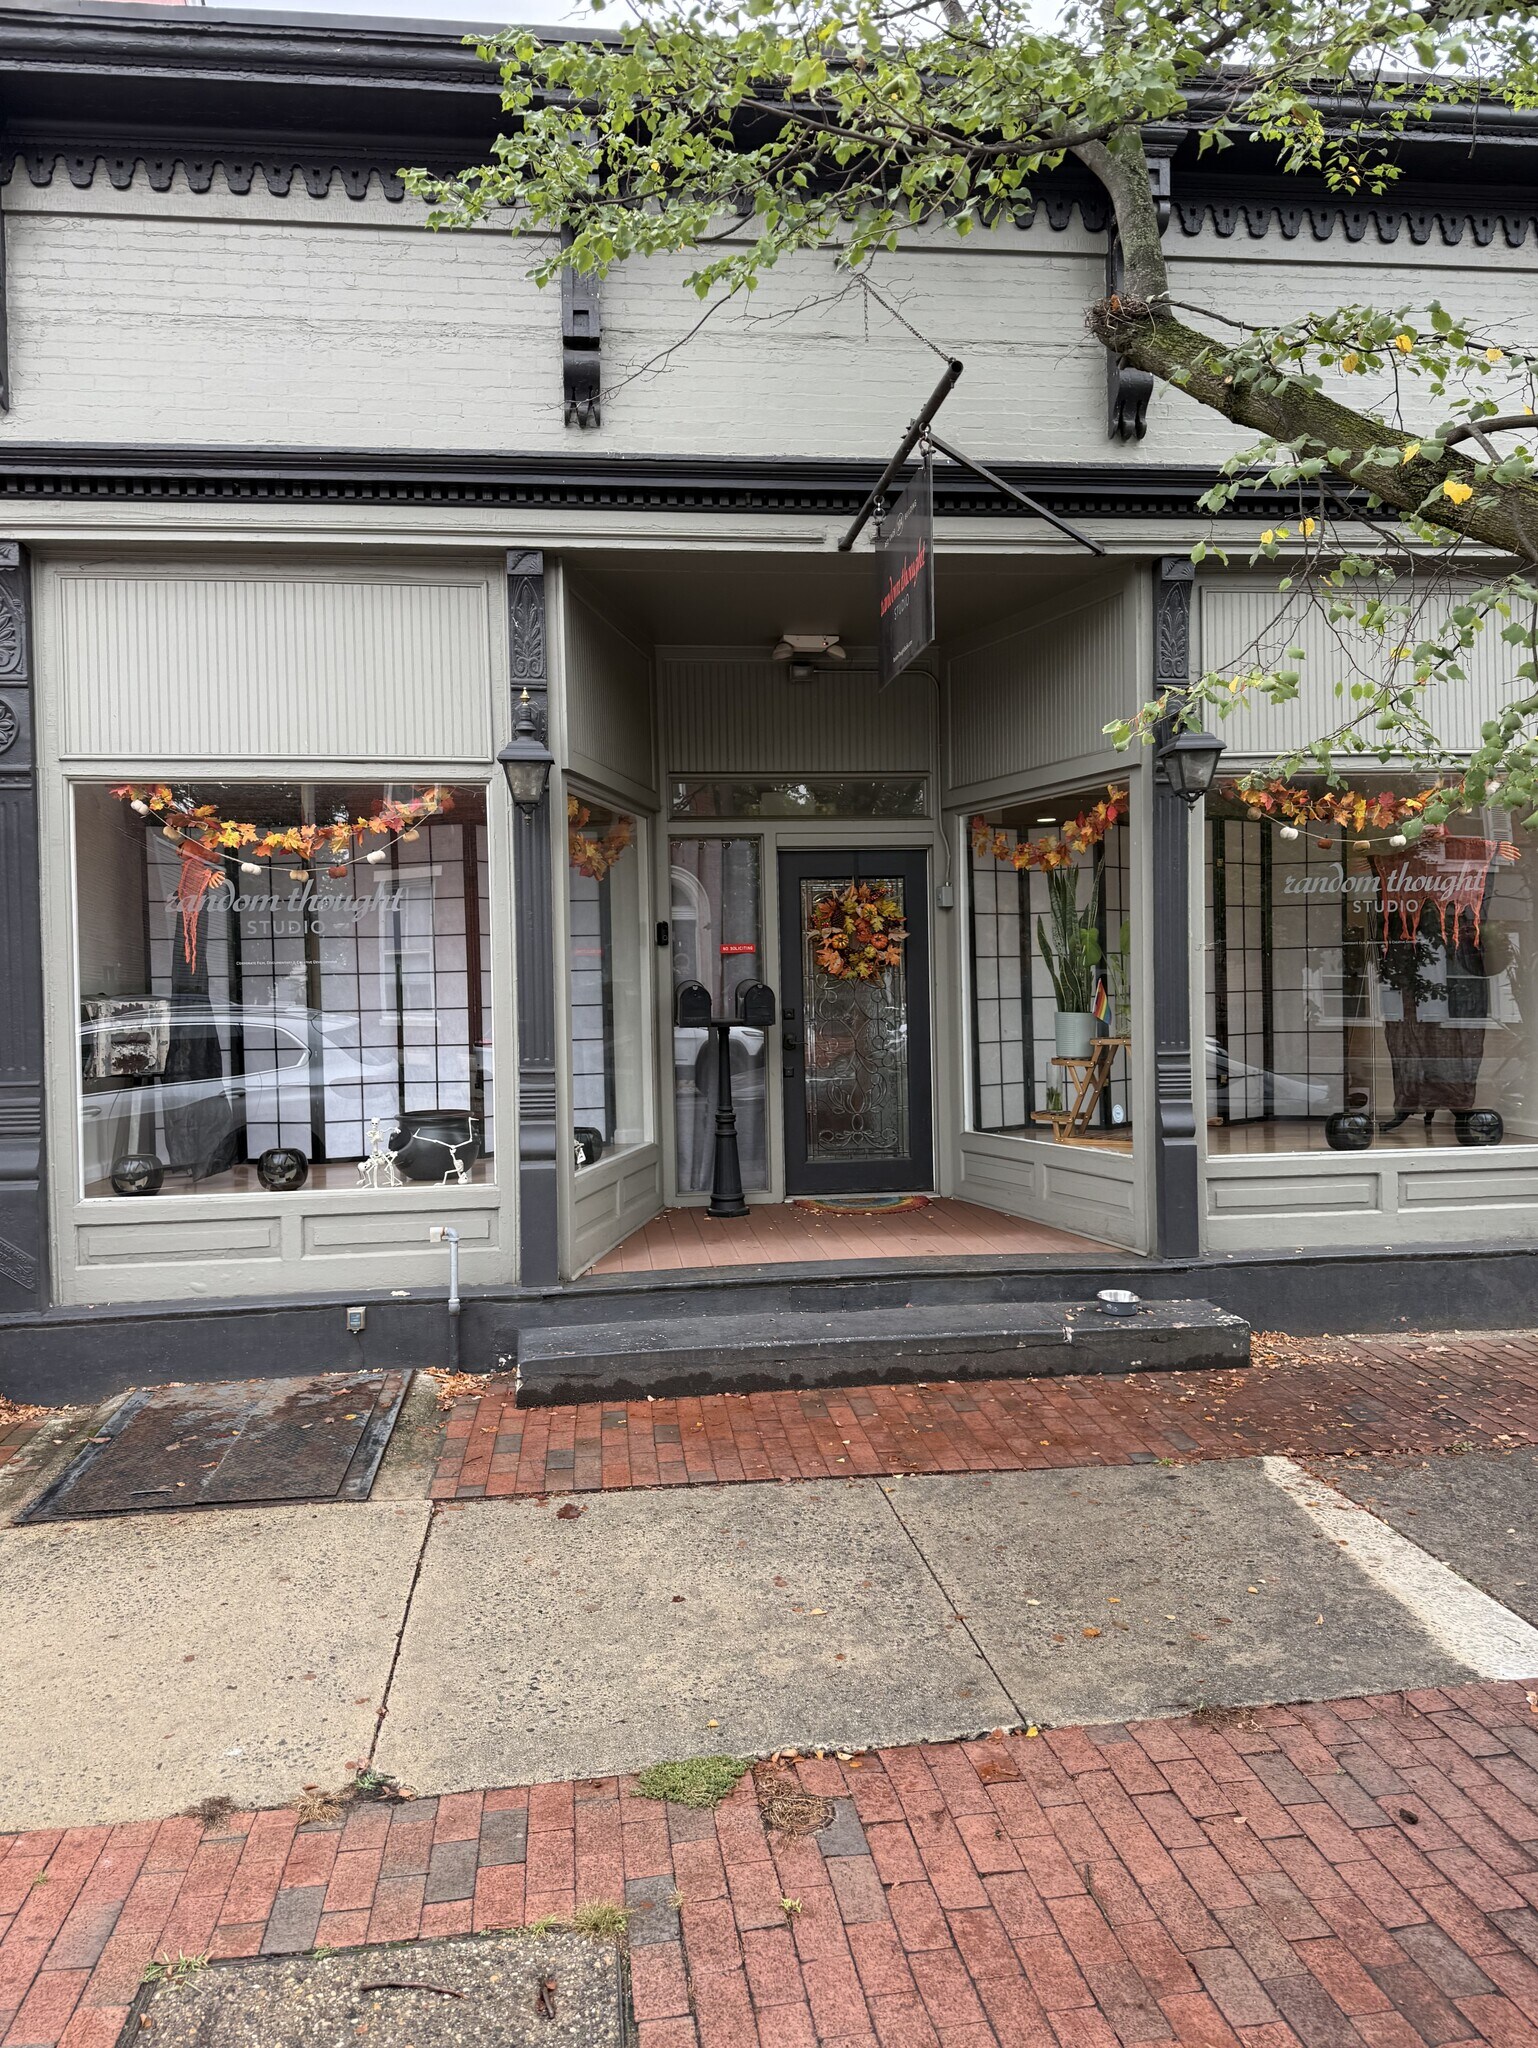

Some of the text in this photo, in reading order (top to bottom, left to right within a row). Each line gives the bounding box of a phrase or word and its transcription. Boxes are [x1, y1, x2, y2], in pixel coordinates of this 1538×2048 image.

[901, 536, 926, 592] thought
[893, 592, 910, 620] STUDIO
[1283, 861, 1486, 901] random thought
[165, 878, 405, 922] random thought
[1352, 899, 1419, 914] STUDIO
[246, 919, 326, 935] STUDIO
